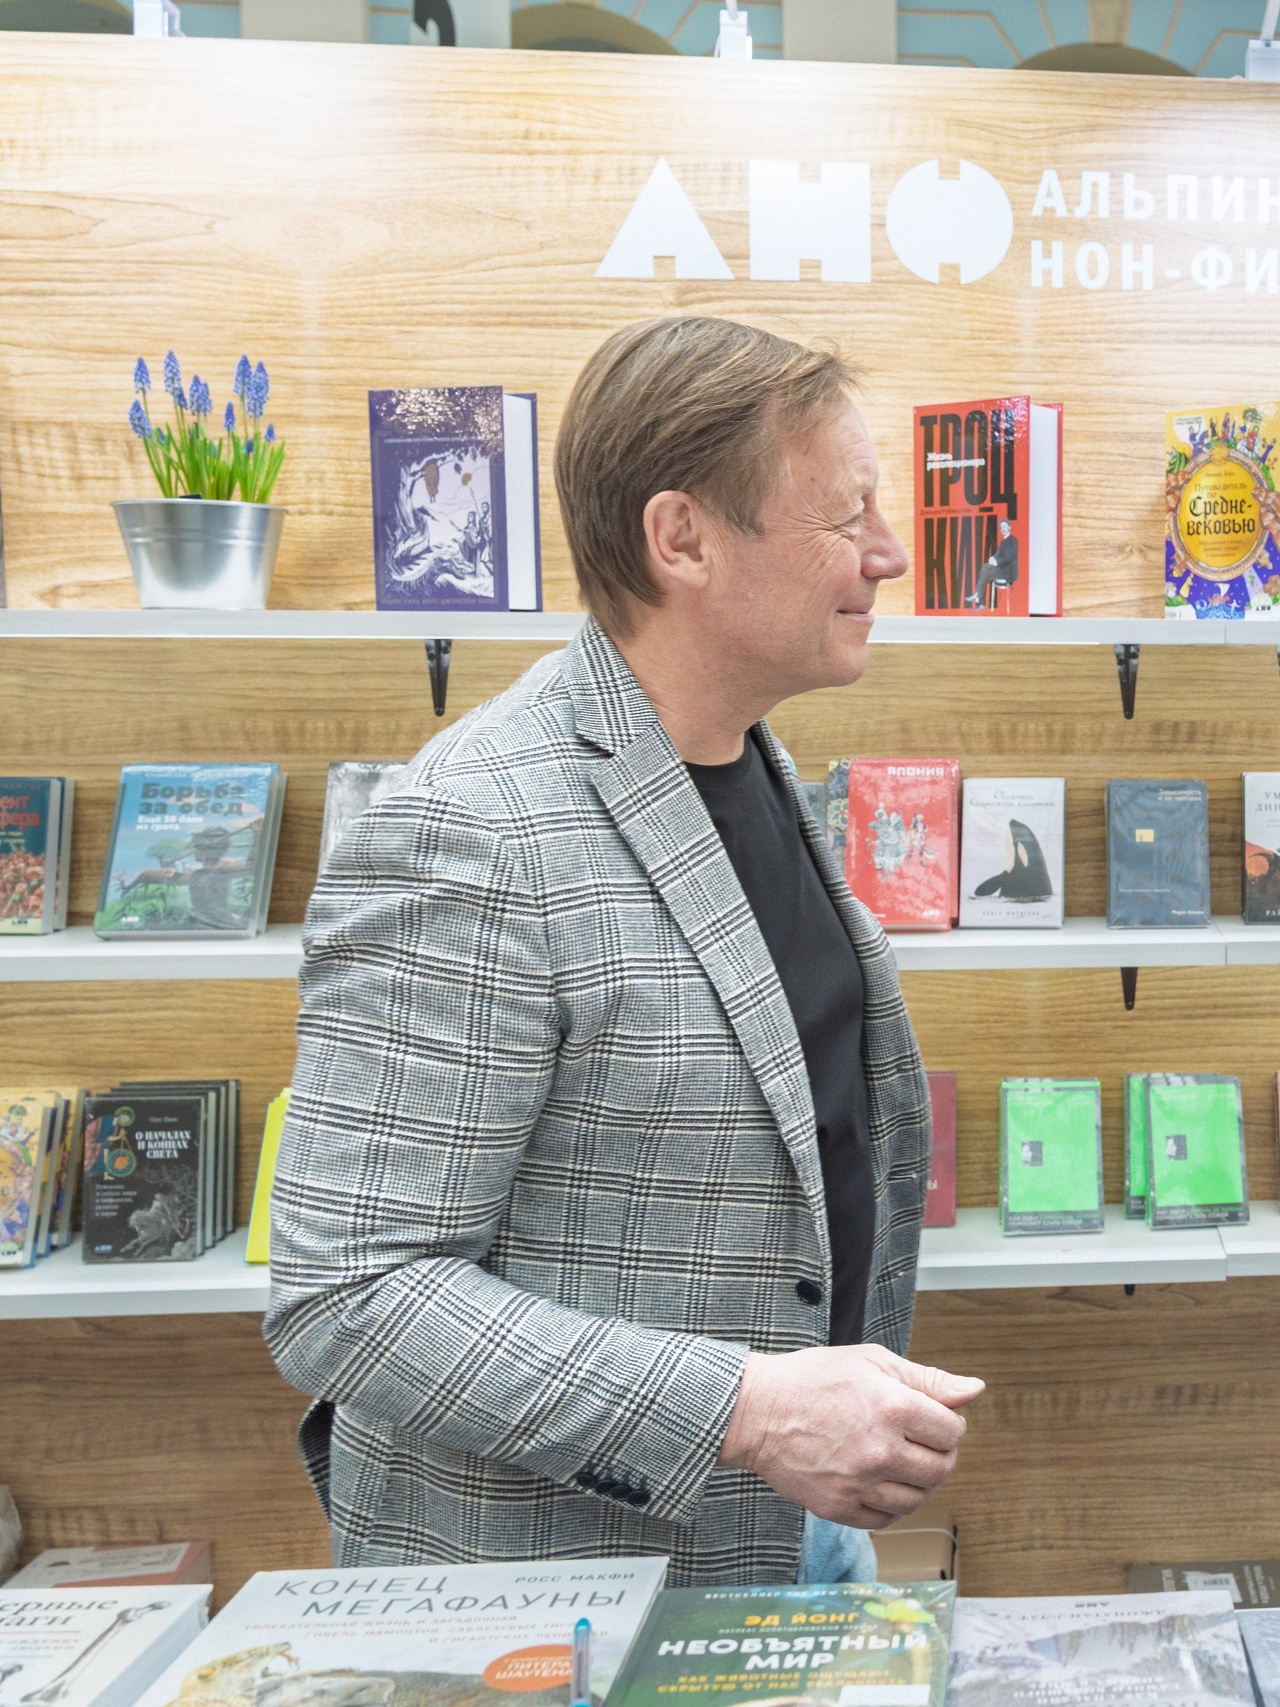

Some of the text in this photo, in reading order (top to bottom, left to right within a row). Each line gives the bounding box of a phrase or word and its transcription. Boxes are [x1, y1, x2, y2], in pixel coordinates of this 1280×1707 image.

[920, 410, 1018, 521] ТРОЦ
[1189, 495, 1253, 519] Средне-
[1186, 518, 1256, 537] вековью
[886, 766, 945, 778] ЯПОНИЯ
[141, 782, 246, 803] Борьба
[138, 799, 244, 817] за обед
[0, 807, 41, 831] фера
[145, 1130, 192, 1141] НАЧАЛАХ
[147, 1140, 189, 1151] КОНЦАХ
[146, 1149, 179, 1159] СВЕТА
[514, 1572, 635, 1584] РОСС МАКФИ
[274, 1576, 448, 1597] КОНЕЦ
[0, 1600, 118, 1616] ервые
[301, 1590, 626, 1617] МЕГАФАУНЫ
[0, 1614, 73, 1627] аги
[744, 1612, 860, 1627] ЭД ЙОНГ
[656, 1630, 928, 1656] НЕОБЪЯТНЫЙ
[506, 1660, 571, 1671] ПИТЕРА
[744, 1652, 836, 1671] МИР
[494, 1669, 573, 1680] ШАУТЕНА
[677, 1674, 708, 1684] КАК
